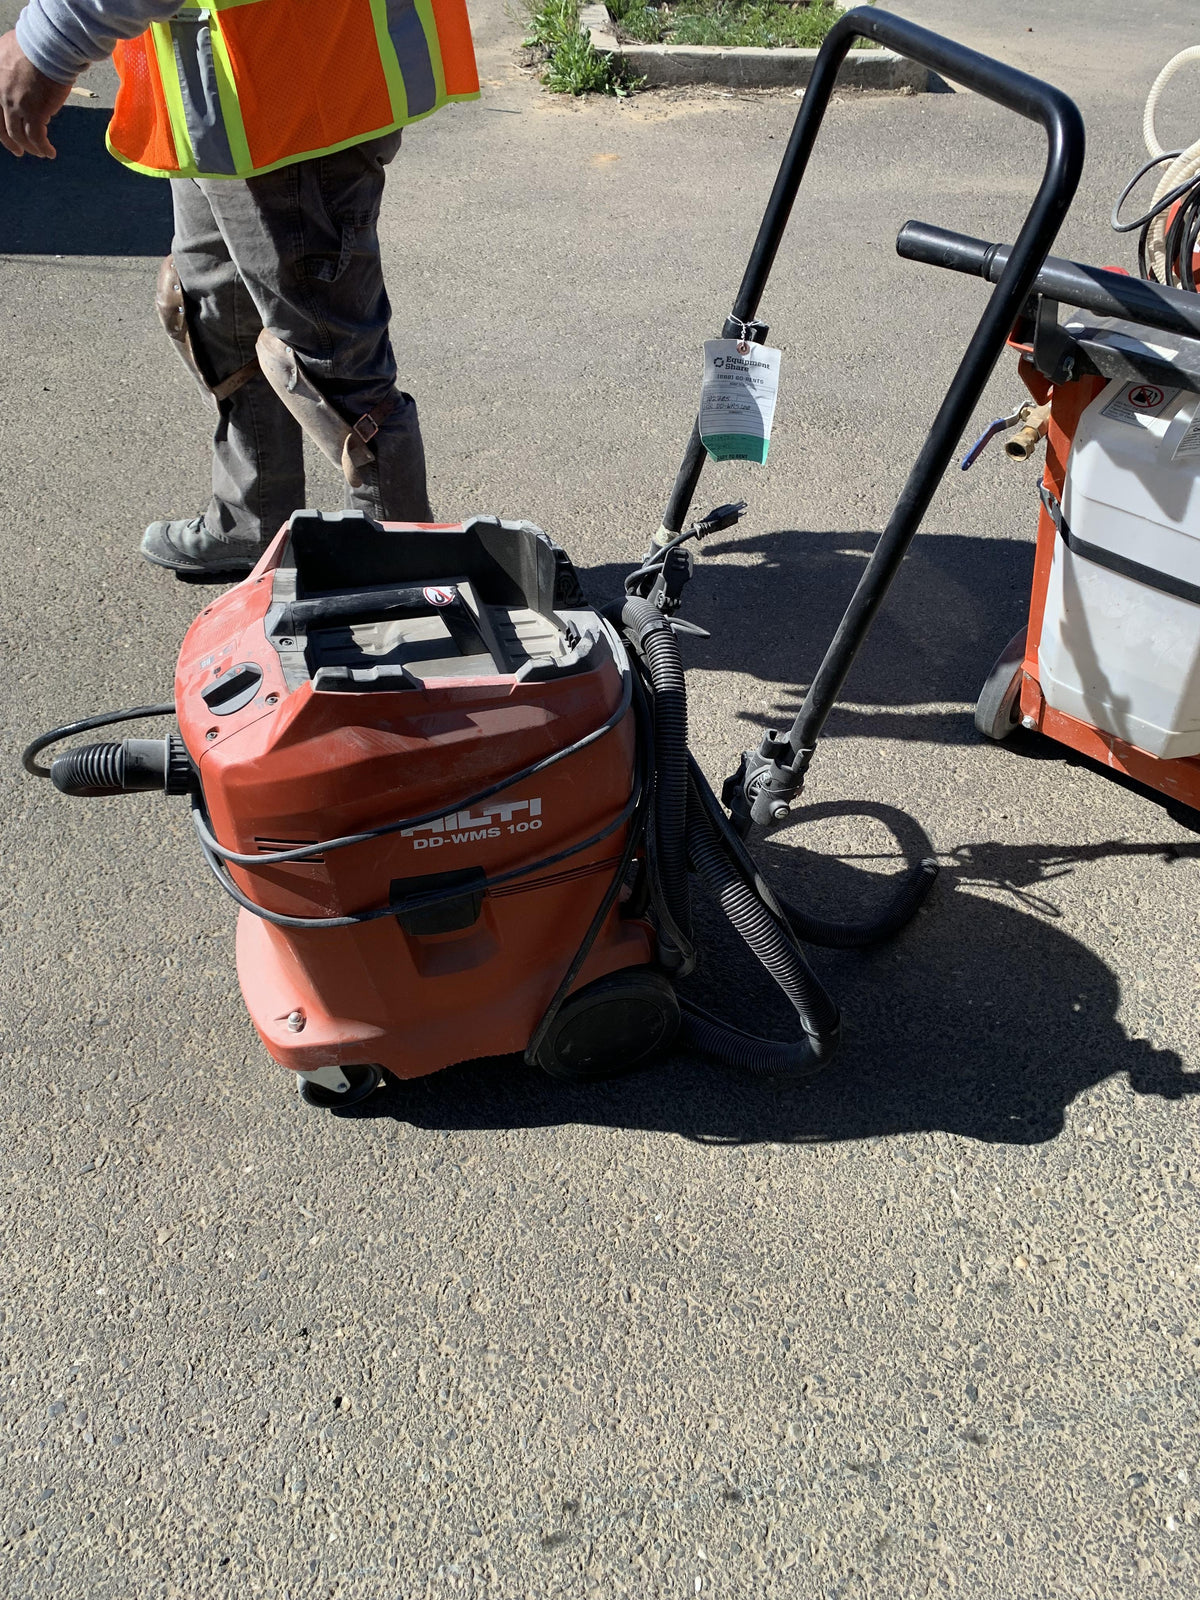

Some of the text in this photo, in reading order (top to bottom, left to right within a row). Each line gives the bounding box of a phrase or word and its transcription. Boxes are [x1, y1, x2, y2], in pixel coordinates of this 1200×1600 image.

[725, 363, 749, 372] Share
[726, 355, 771, 370] Equipment
[413, 819, 542, 850] DD-WMS 100
